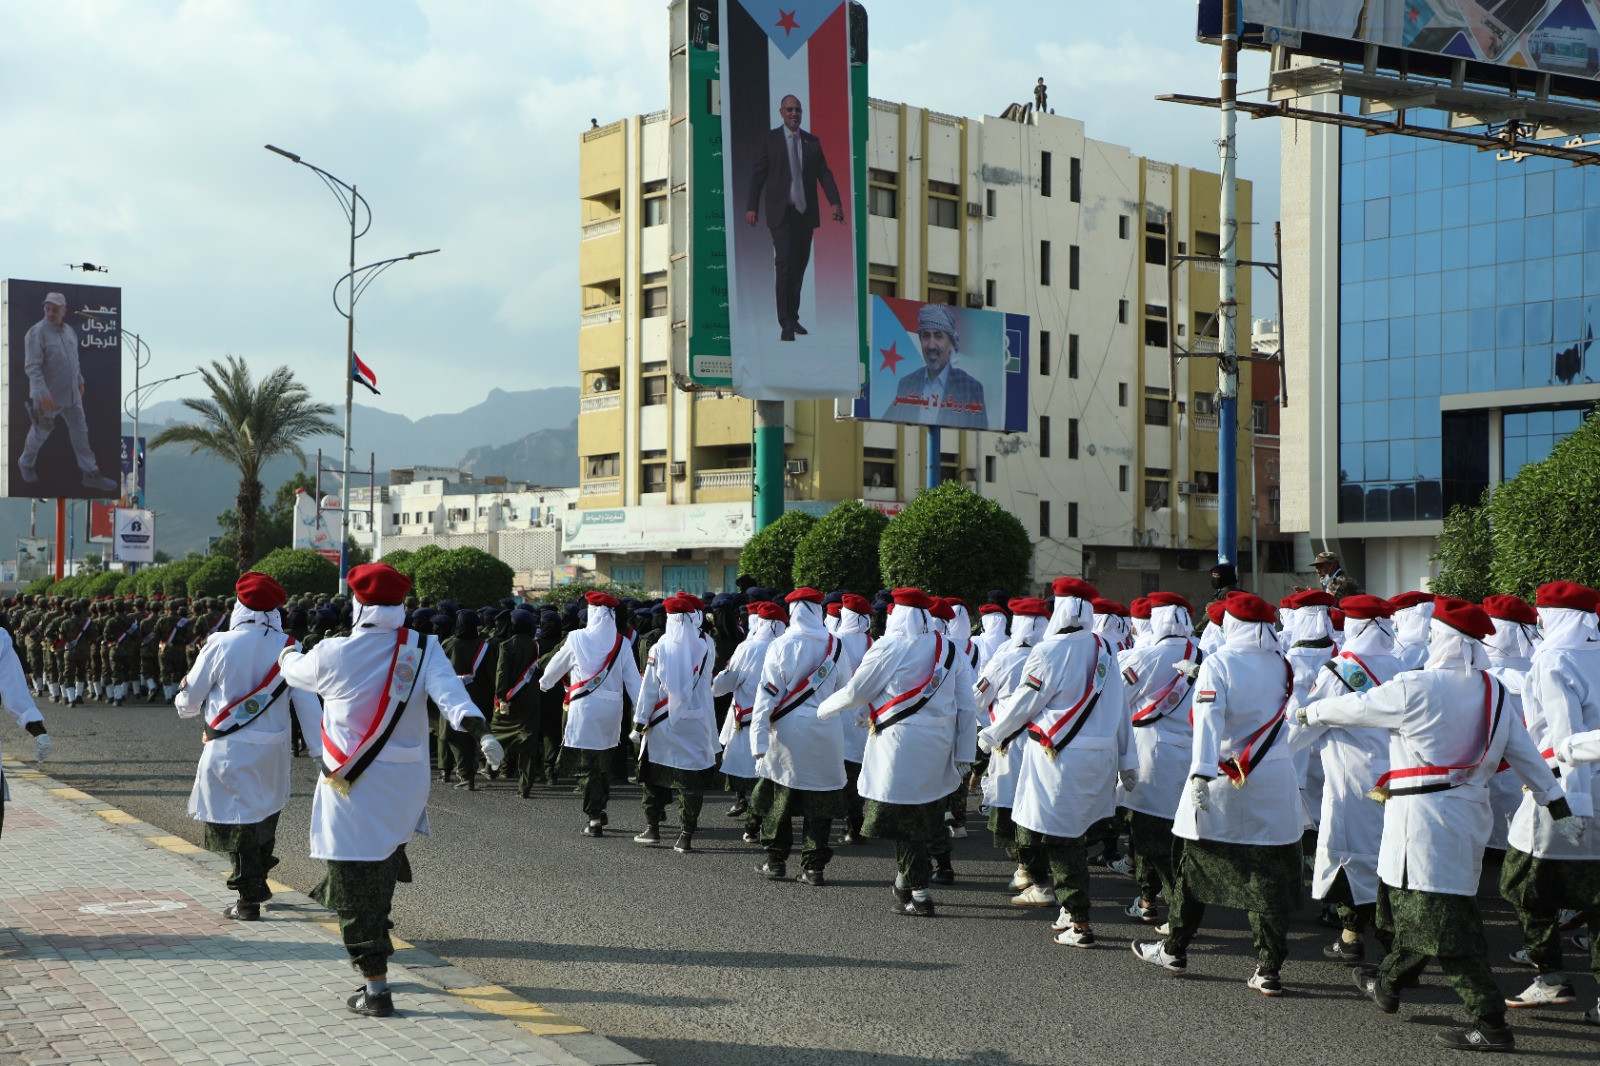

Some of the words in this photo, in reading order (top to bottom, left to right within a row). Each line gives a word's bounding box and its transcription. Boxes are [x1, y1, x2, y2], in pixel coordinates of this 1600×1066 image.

[81, 304, 117, 315] عهد
[81, 318, 117, 333] الرجال
[81, 334, 117, 349] للرجال
[893, 390, 930, 410] ينكسر
[931, 393, 939, 407] لا
